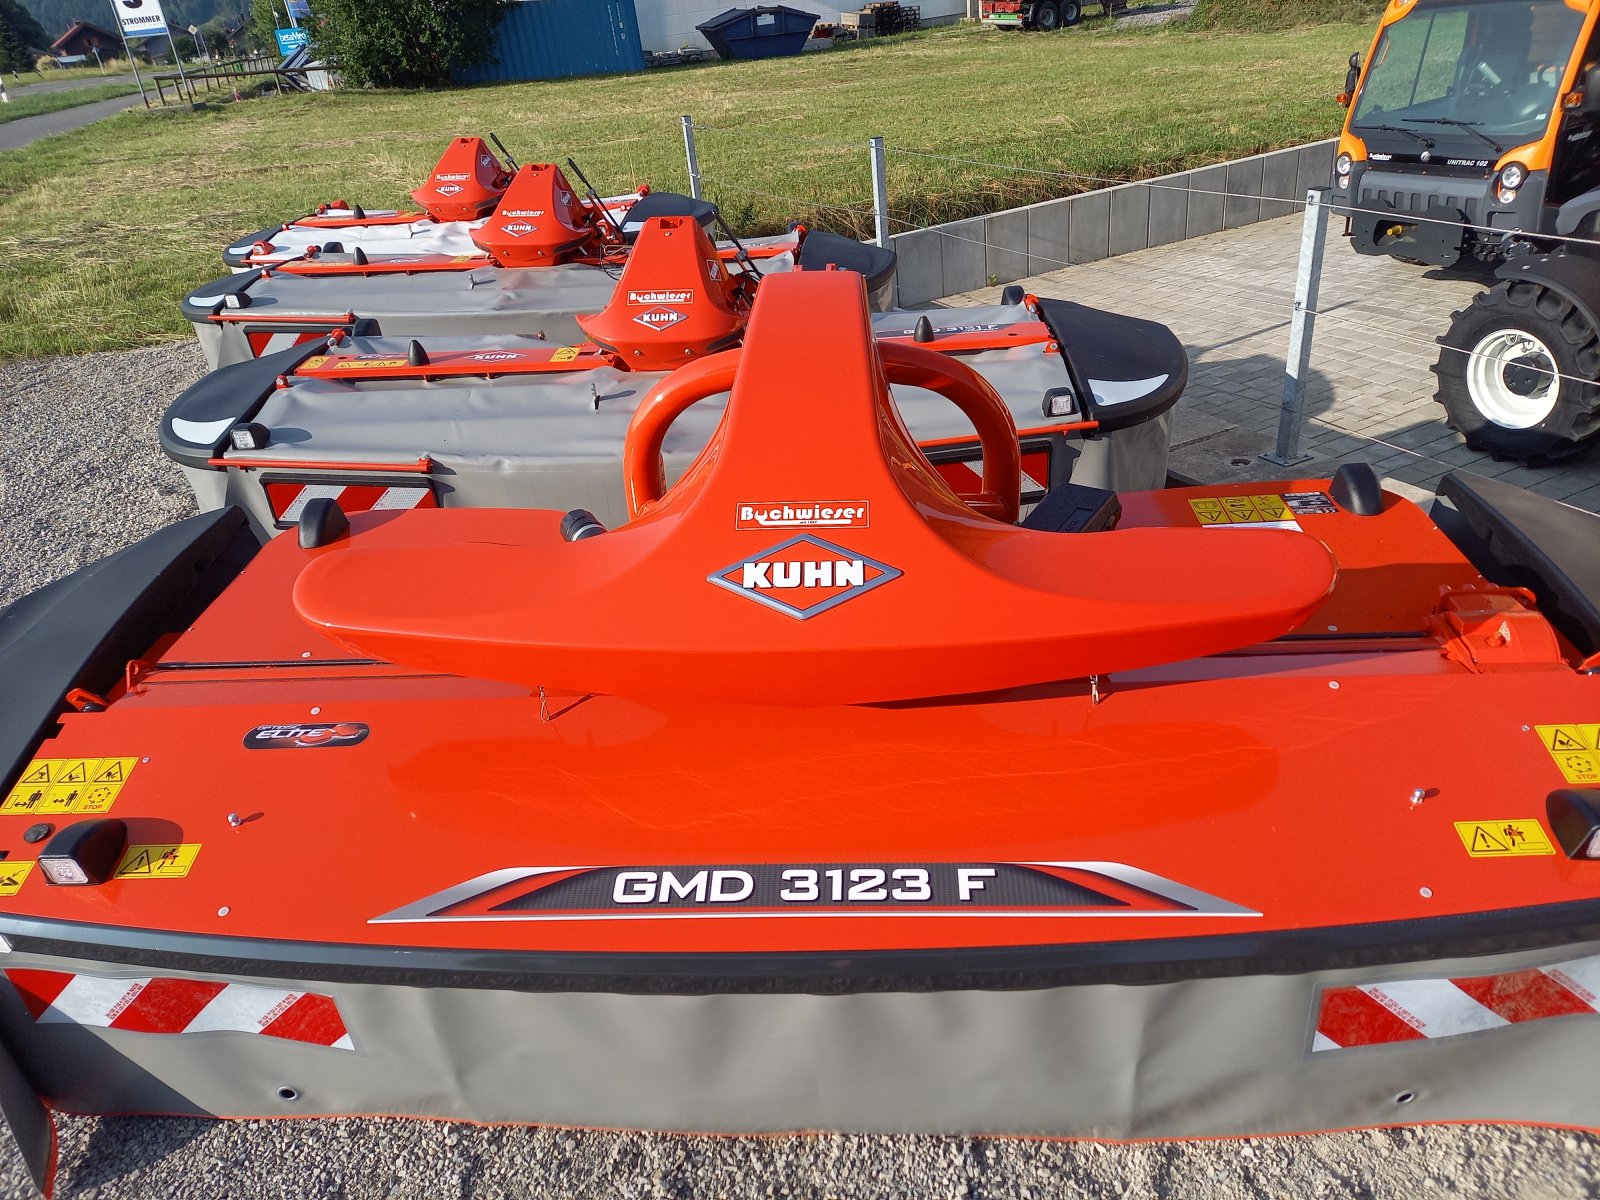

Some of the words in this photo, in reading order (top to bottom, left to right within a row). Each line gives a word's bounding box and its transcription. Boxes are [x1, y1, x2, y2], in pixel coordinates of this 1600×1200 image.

[122, 15, 161, 25] STROMMER
[629, 291, 691, 303] Buchwieser
[642, 312, 678, 322] KUHN
[740, 504, 864, 525] Buchwieser
[742, 560, 864, 589] KUHN
[255, 728, 328, 739] ELITE
[612, 870, 754, 903] GMD
[780, 868, 932, 901] 3123
[957, 868, 996, 901] F
